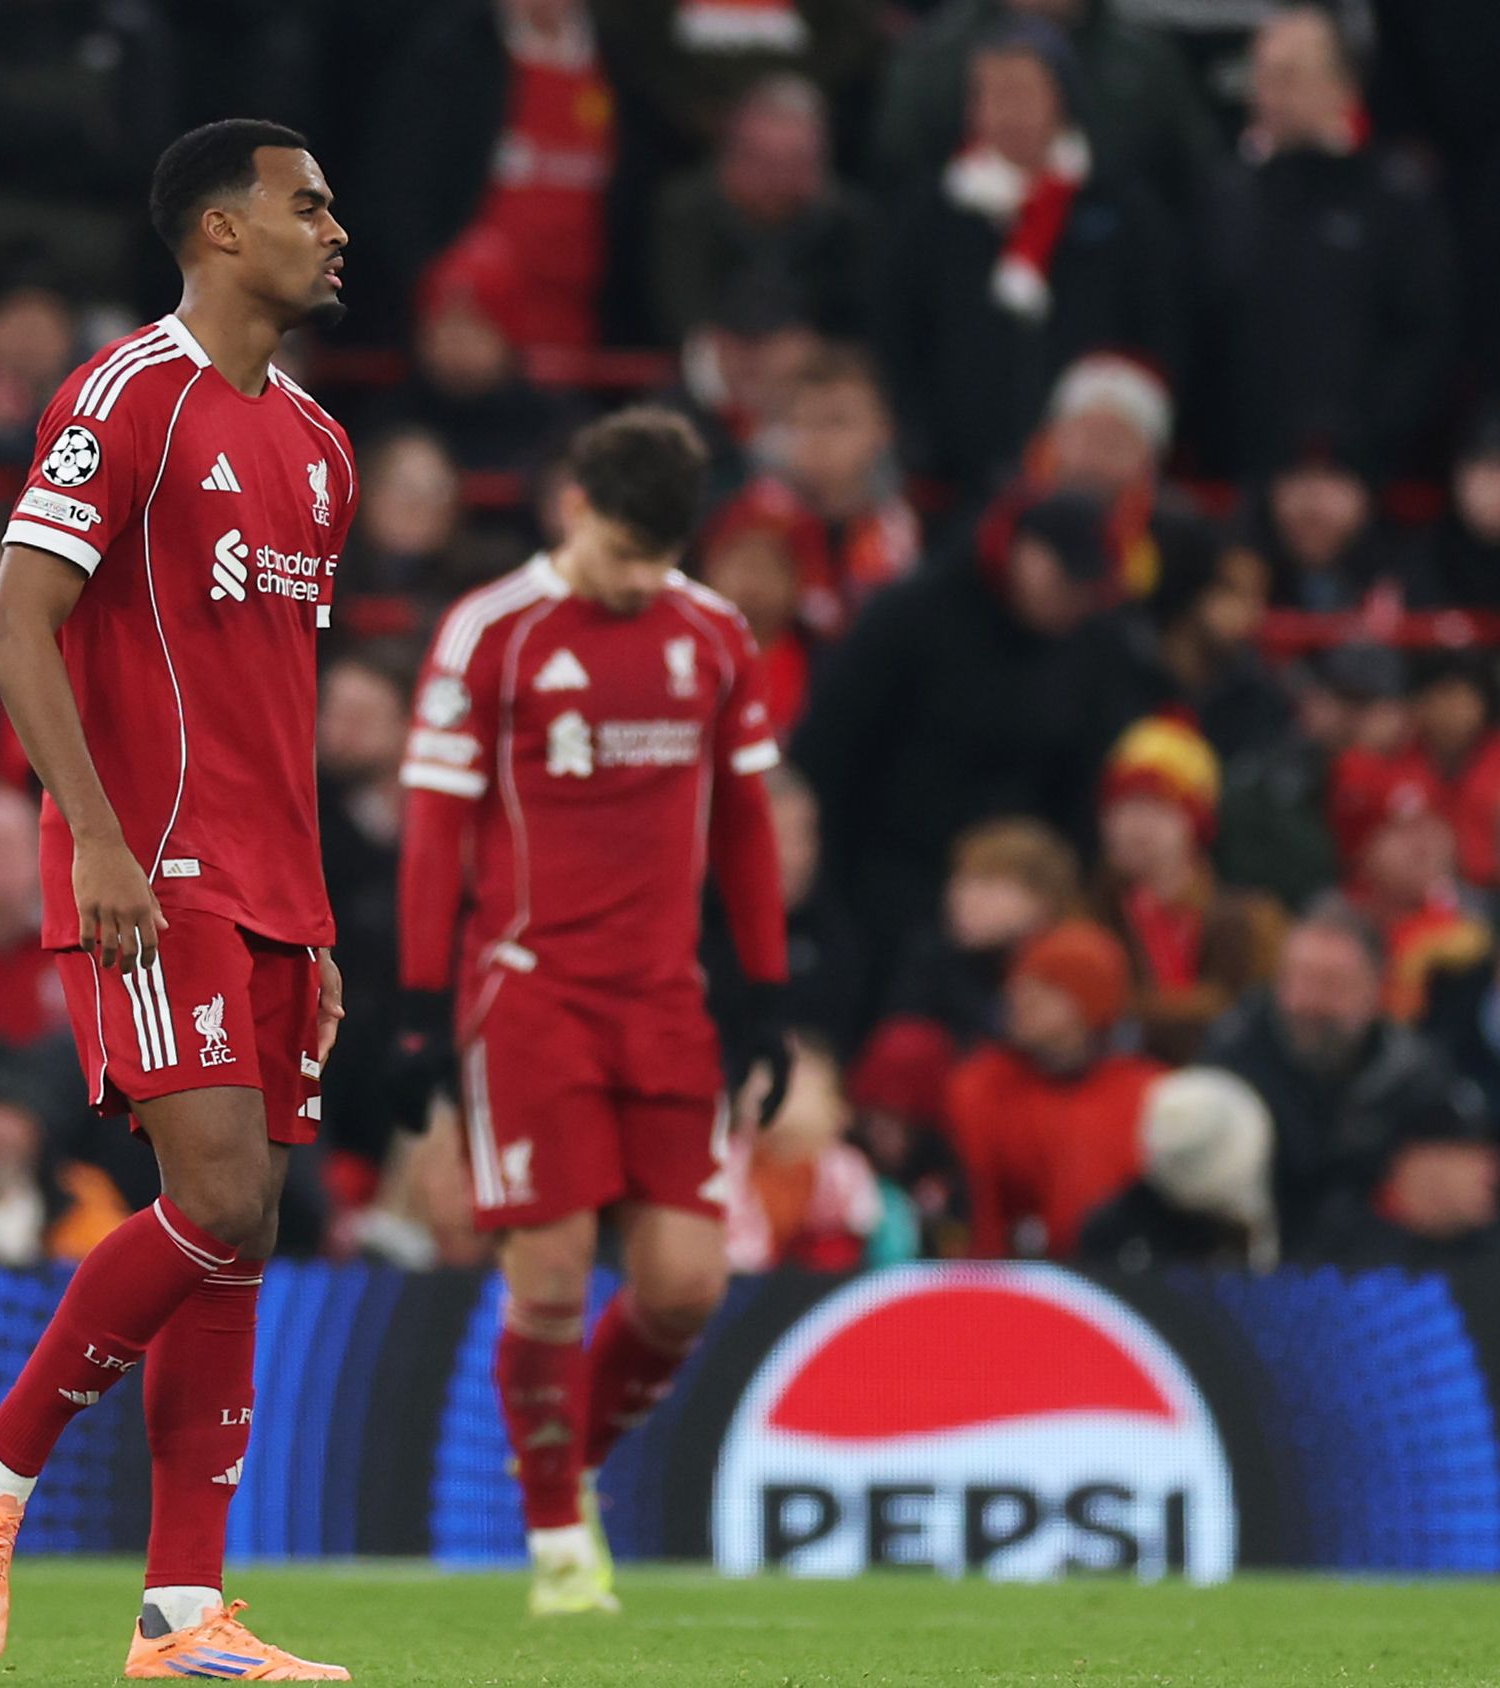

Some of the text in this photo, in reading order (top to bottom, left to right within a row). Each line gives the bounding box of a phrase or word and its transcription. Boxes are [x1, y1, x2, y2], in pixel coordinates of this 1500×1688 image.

[68, 504, 90, 523] 10
[219, 1407, 255, 1426] LF
[762, 1481, 1187, 1574] PEPSI
